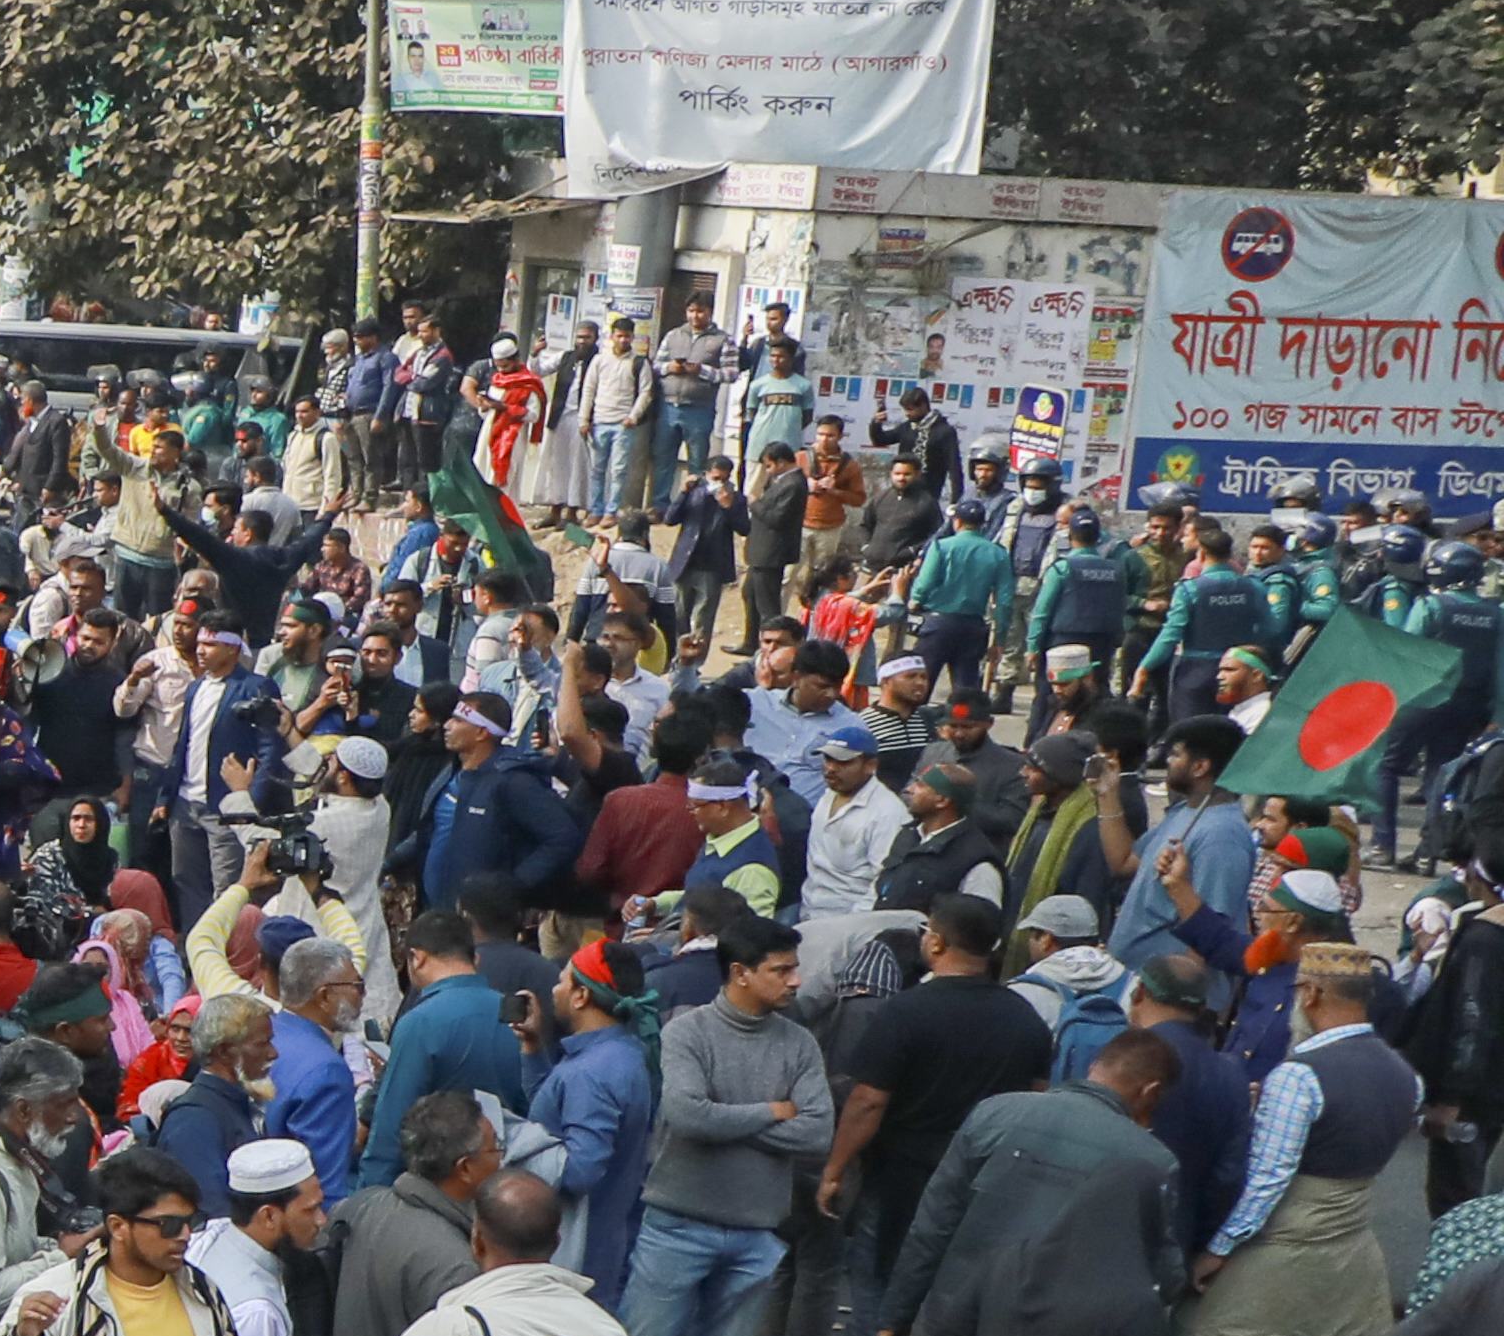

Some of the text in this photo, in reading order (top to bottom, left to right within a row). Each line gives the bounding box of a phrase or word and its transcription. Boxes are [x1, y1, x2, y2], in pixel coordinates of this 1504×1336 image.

[877, 1, 897, 16] না
[464, 44, 511, 65] প্রতিষ্ঠা
[582, 47, 643, 68] পুরাতন
[715, 54, 772, 72] মেলার
[780, 51, 824, 72] মাঠে
[678, 84, 836, 118] পার্কিং করুন
[1170, 290, 1267, 376] যাত্রী
[1172, 400, 1230, 431] ১০০
[1244, 403, 1291, 434] গজ
[1298, 404, 1383, 436] সামনে
[1391, 406, 1443, 436] বাস
[1327, 457, 1417, 496] বিভাগ
[1208, 593, 1247, 606] POLICE
[1452, 614, 1494, 628] POLICE
